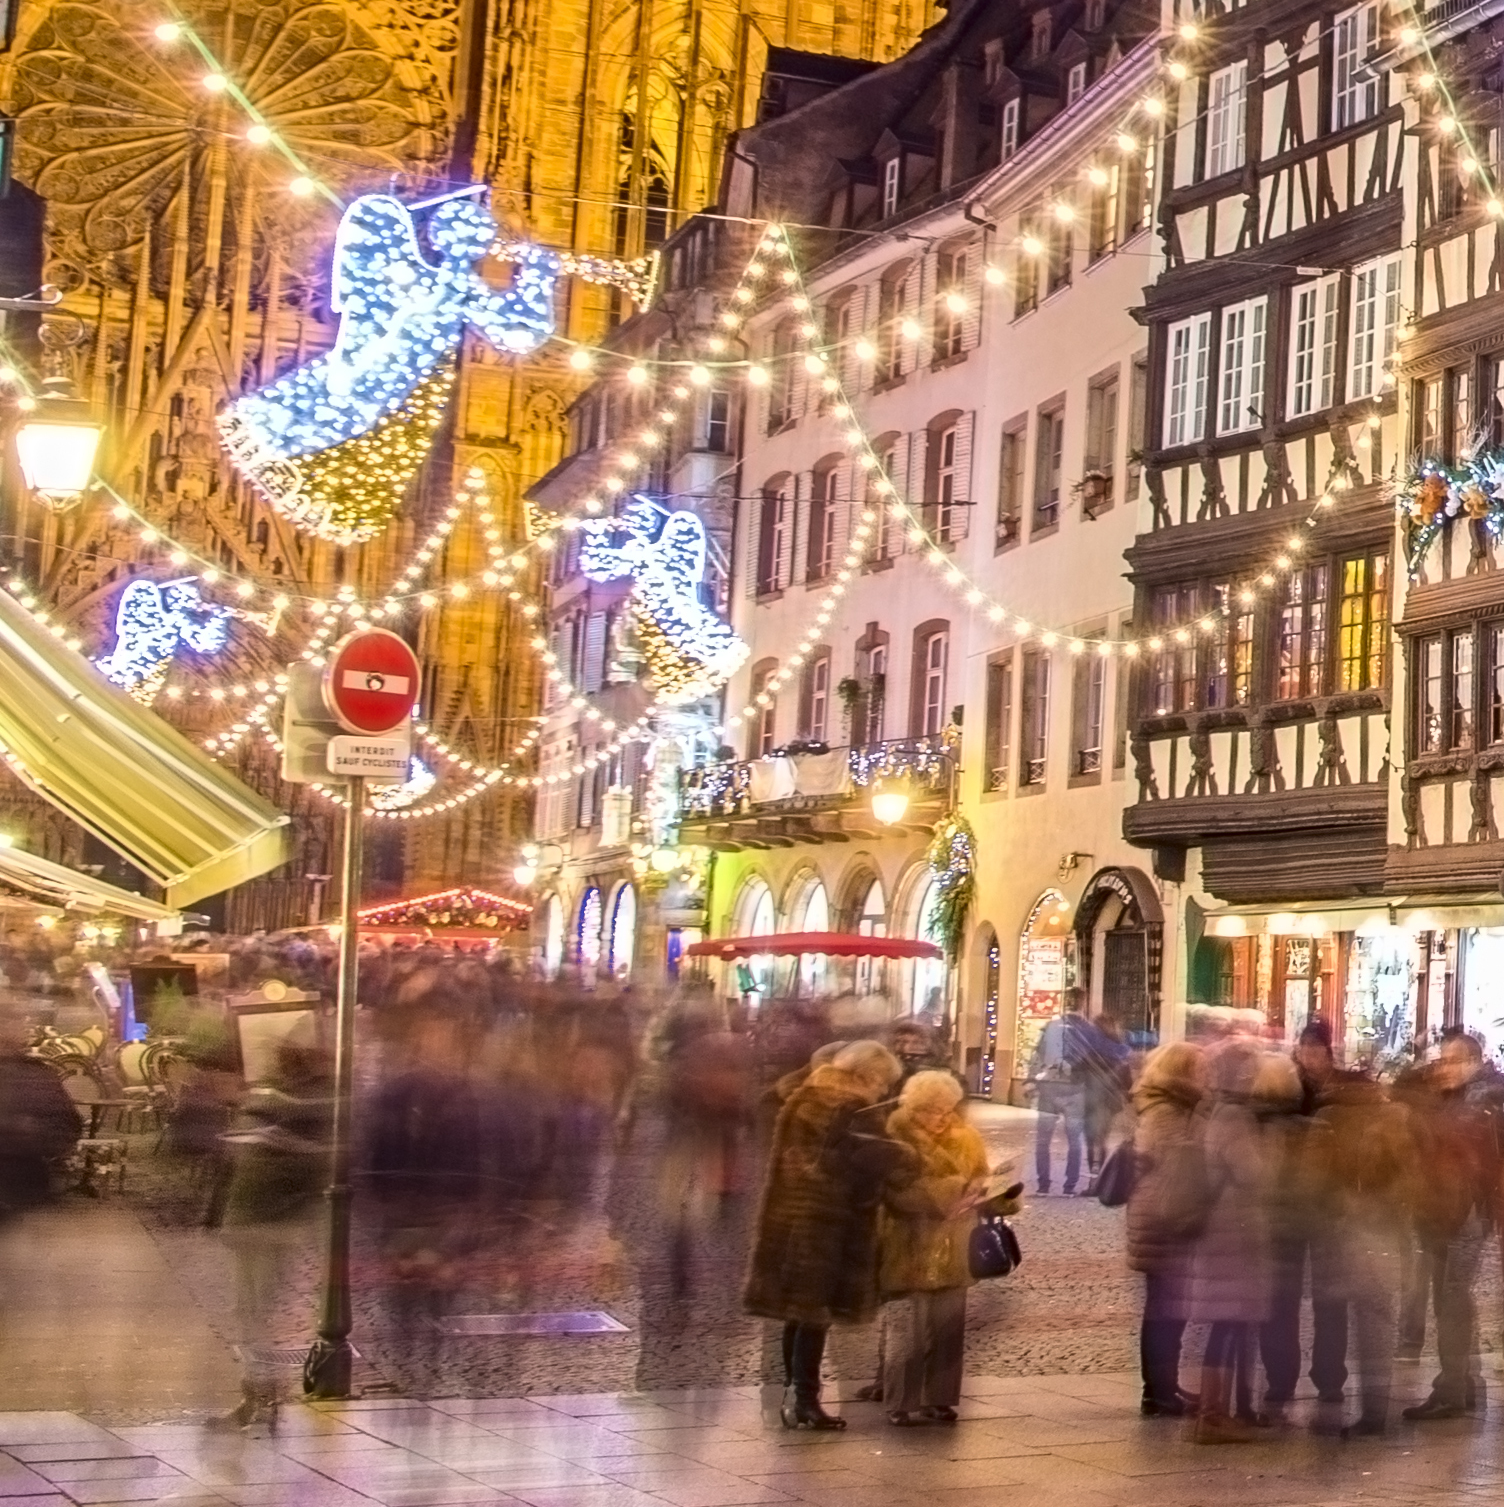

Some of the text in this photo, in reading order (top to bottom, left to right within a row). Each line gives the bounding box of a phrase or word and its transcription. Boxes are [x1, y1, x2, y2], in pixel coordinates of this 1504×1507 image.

[350, 745, 395, 756] INTERDIT
[336, 756, 407, 769] SAUF CYCLISTES
